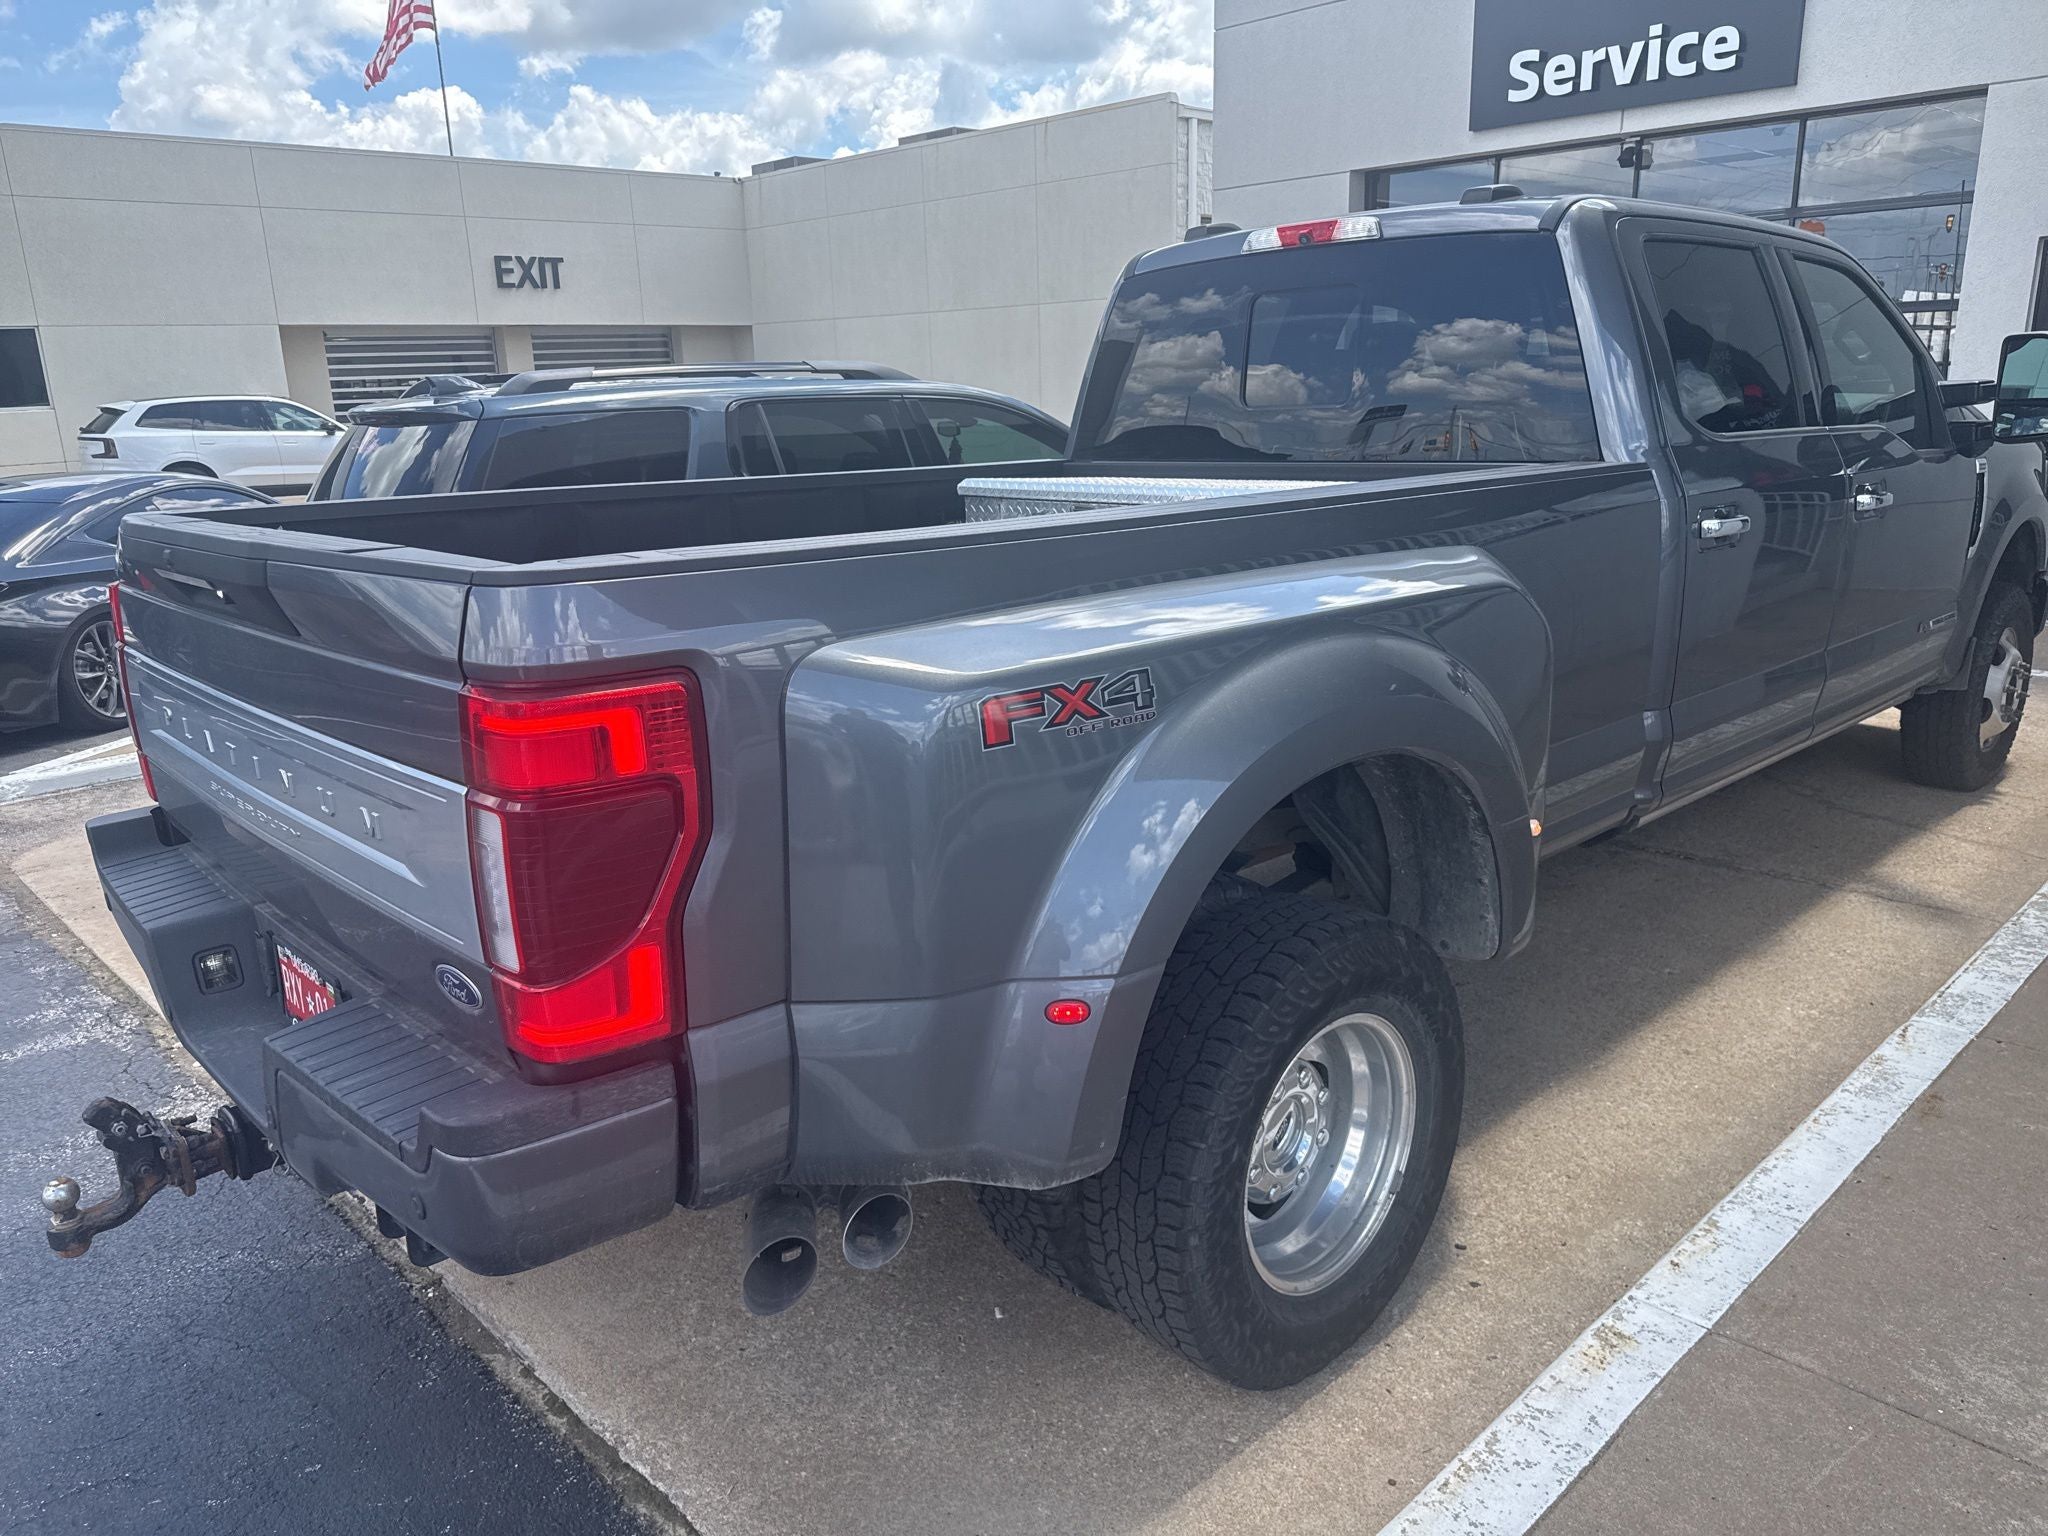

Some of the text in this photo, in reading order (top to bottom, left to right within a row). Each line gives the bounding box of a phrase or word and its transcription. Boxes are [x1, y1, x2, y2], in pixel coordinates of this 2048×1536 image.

[1507, 24, 1741, 103] Service
[494, 255, 564, 289] EXIT
[977, 667, 1156, 752] FX4
[1066, 710, 1157, 738] OFF ROAD
[443, 973, 469, 1003] Ford
